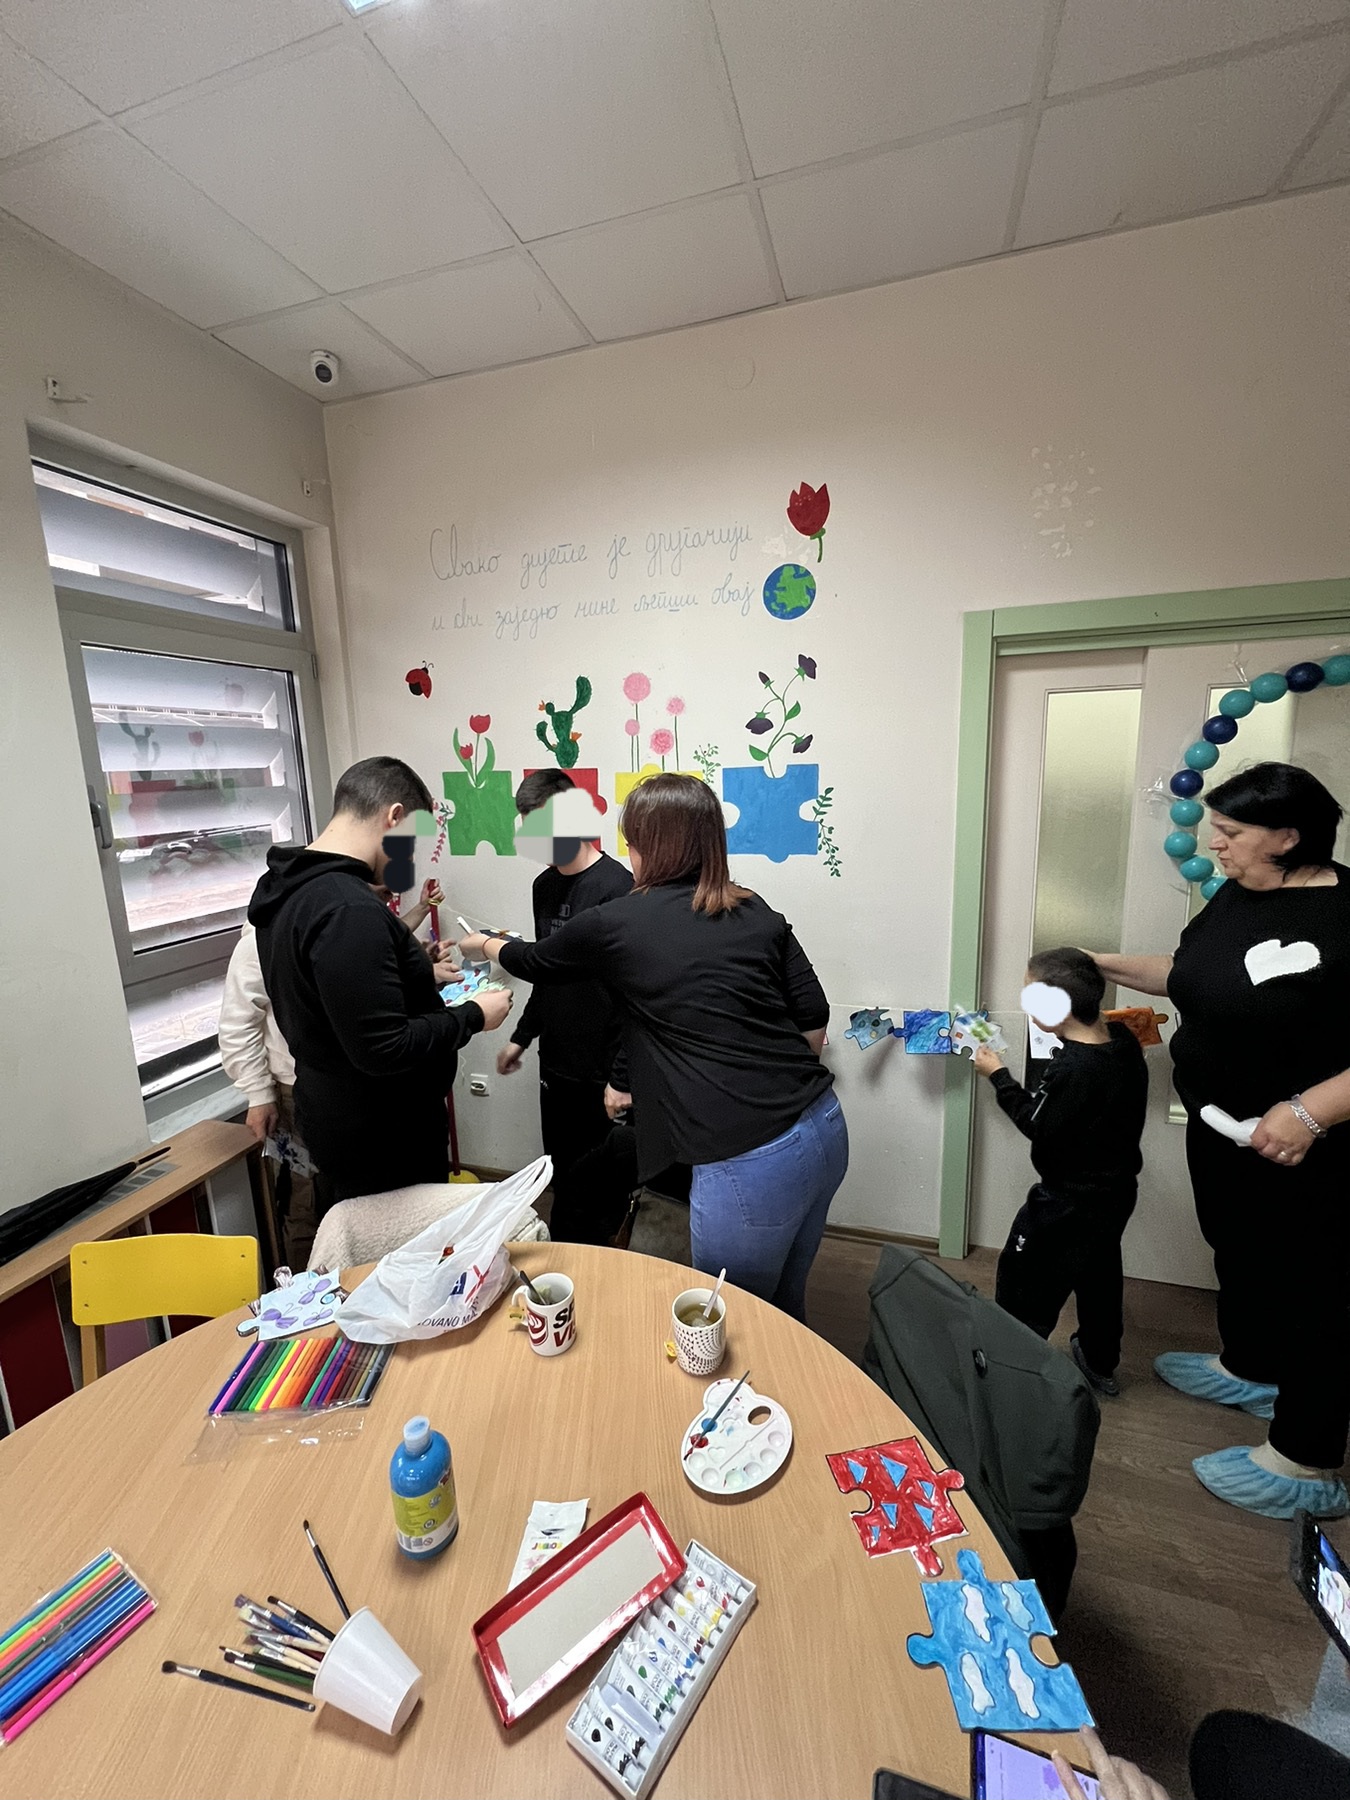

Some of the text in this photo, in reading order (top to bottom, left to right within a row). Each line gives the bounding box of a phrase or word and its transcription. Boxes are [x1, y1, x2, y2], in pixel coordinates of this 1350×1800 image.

[429, 520, 753, 590] Свако дијете је другачији
[431, 572, 755, 642] и сви заједно чине љепши овај
[417, 1316, 460, 1327] OVANO
